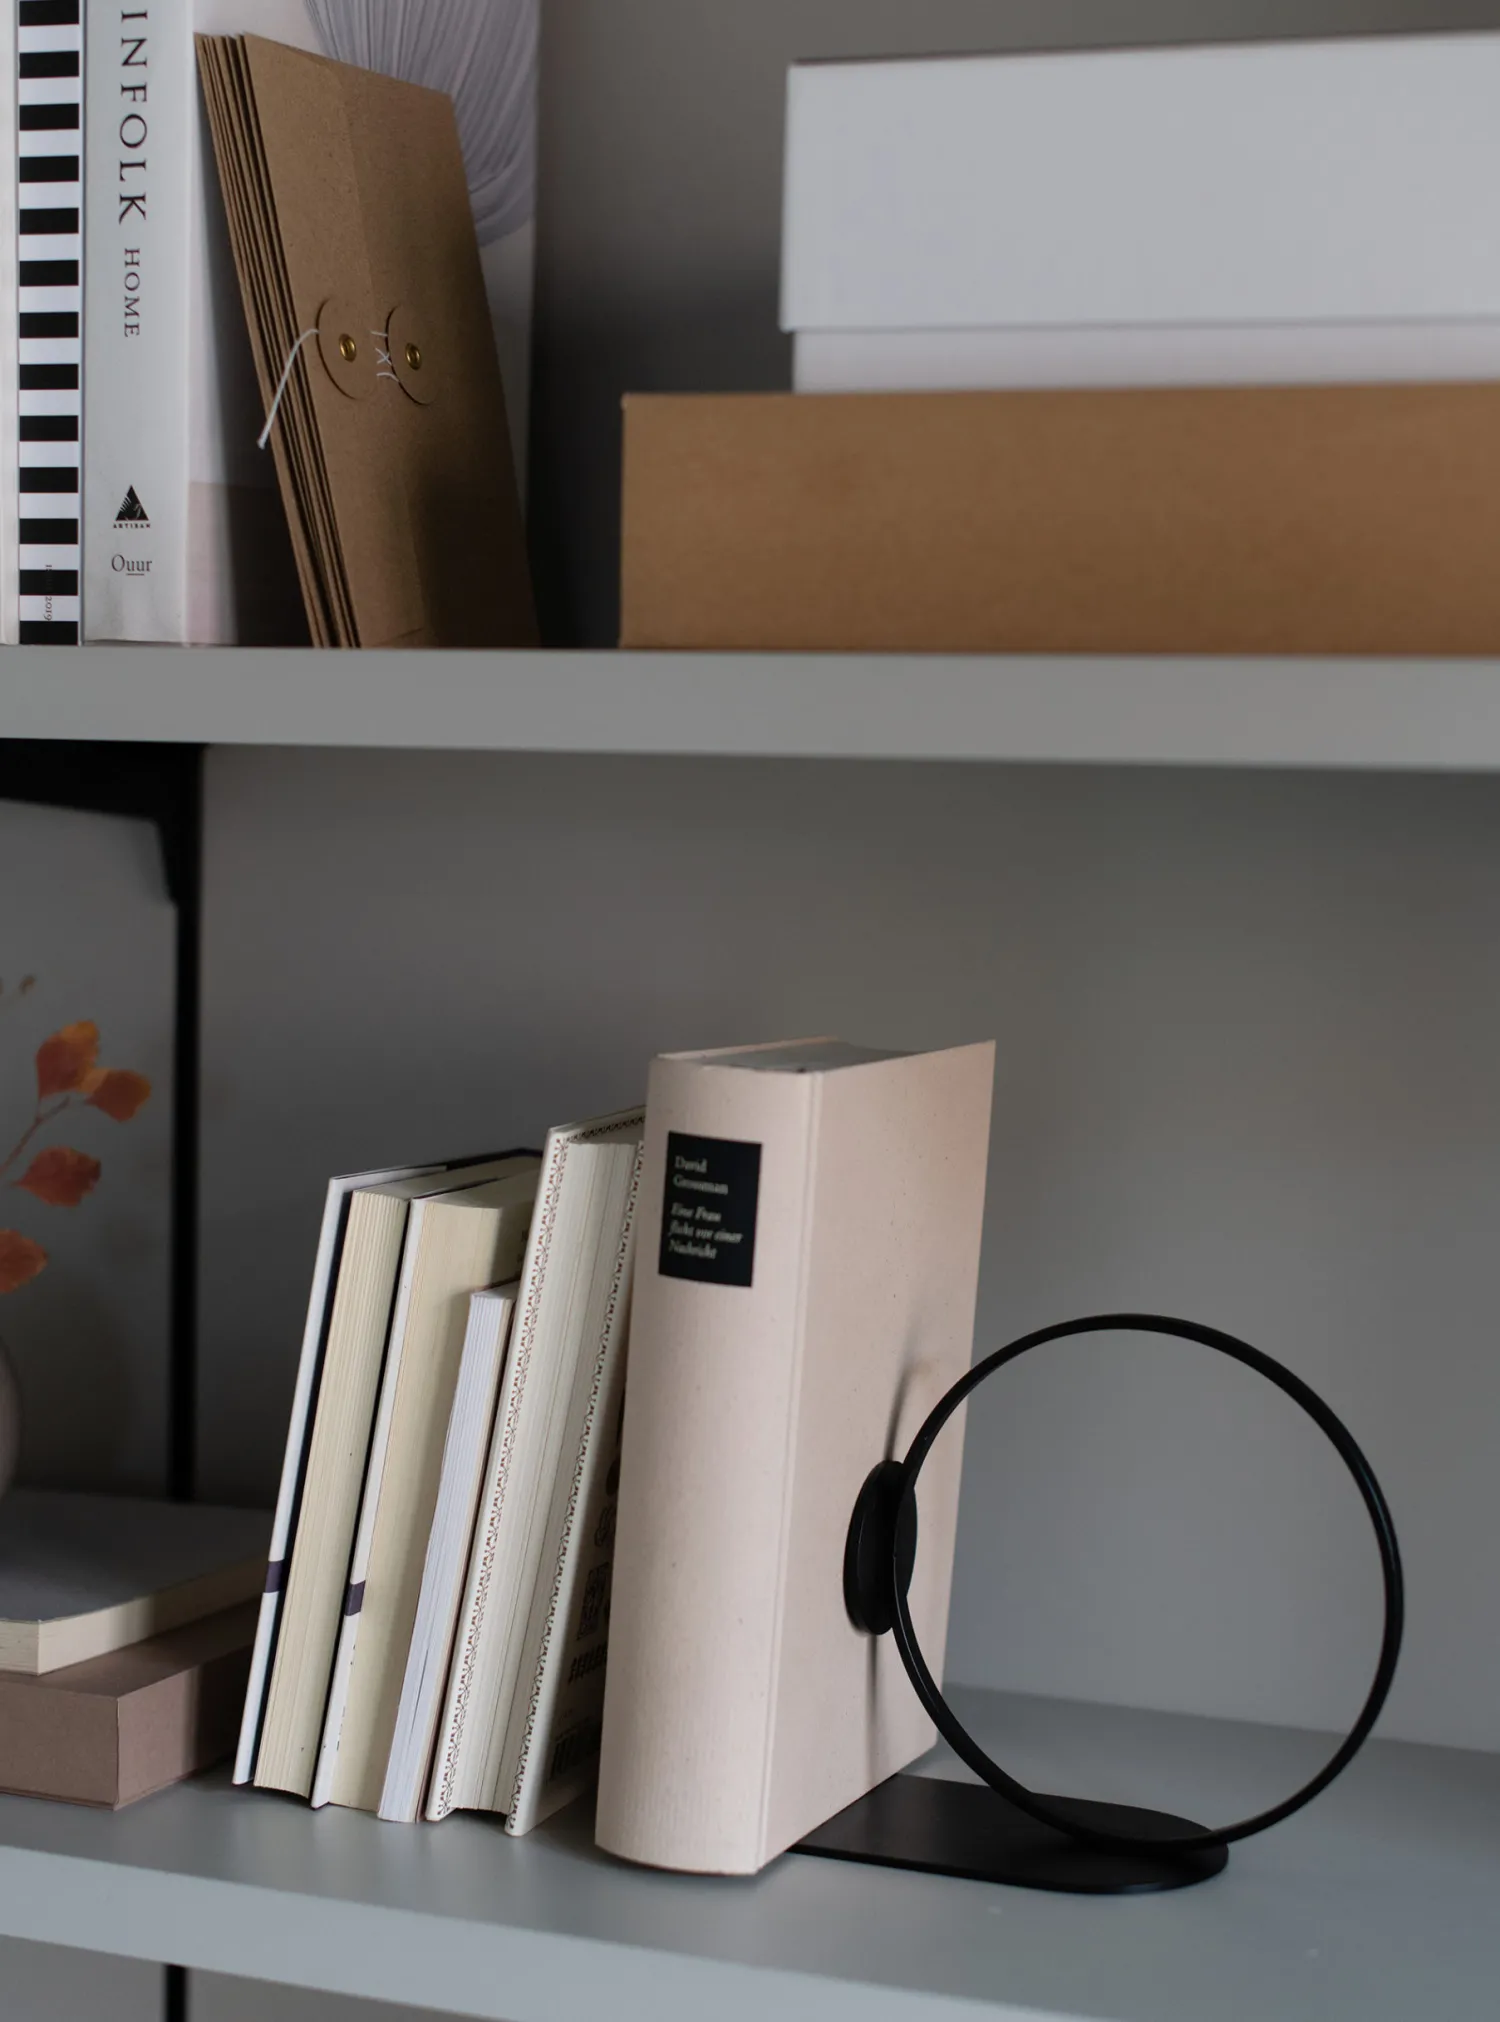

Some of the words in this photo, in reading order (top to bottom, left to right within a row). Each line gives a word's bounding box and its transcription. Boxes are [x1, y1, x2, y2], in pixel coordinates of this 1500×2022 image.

[124, 248, 141, 338] HOME
[111, 554, 153, 572] Ouur
[43, 596, 53, 621] 2019
